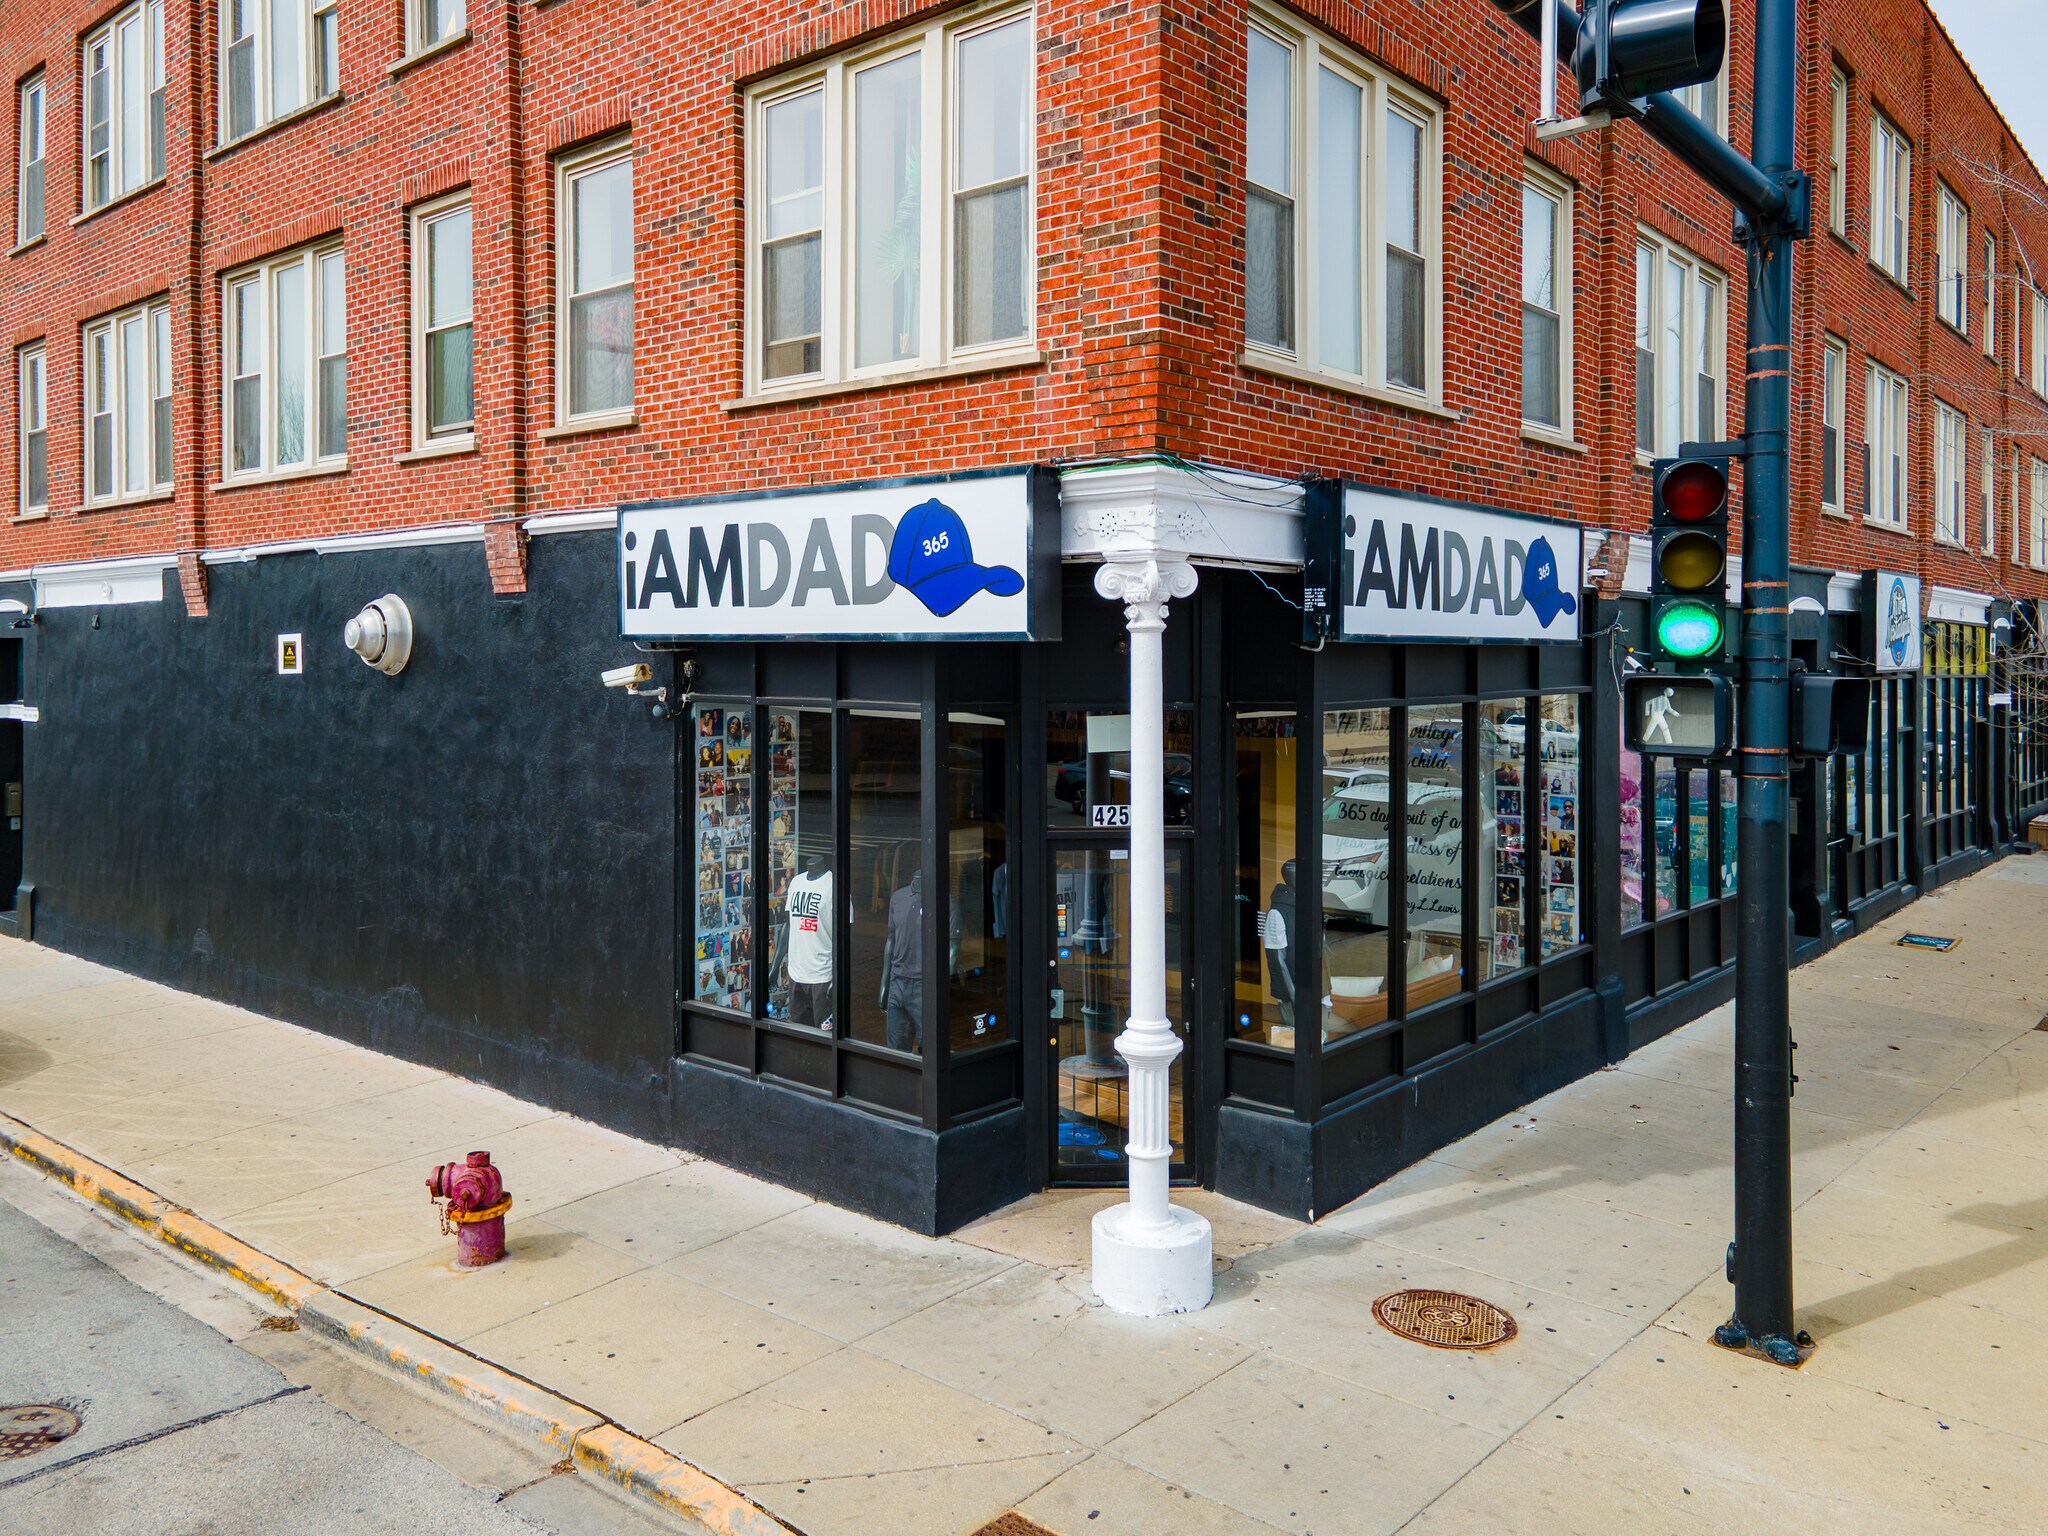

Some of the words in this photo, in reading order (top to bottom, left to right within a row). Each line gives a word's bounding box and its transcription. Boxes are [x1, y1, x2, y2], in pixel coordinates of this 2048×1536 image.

[922, 530, 949, 557] 365
[1538, 562, 1550, 580] 365
[1094, 806, 1129, 825] 425
[1338, 801, 1368, 820] 365
[1406, 810, 1427, 826] out
[1431, 810, 1449, 834] of
[1449, 817, 1461, 829] a
[1446, 840, 1462, 865] of
[799, 917, 818, 932] 365
